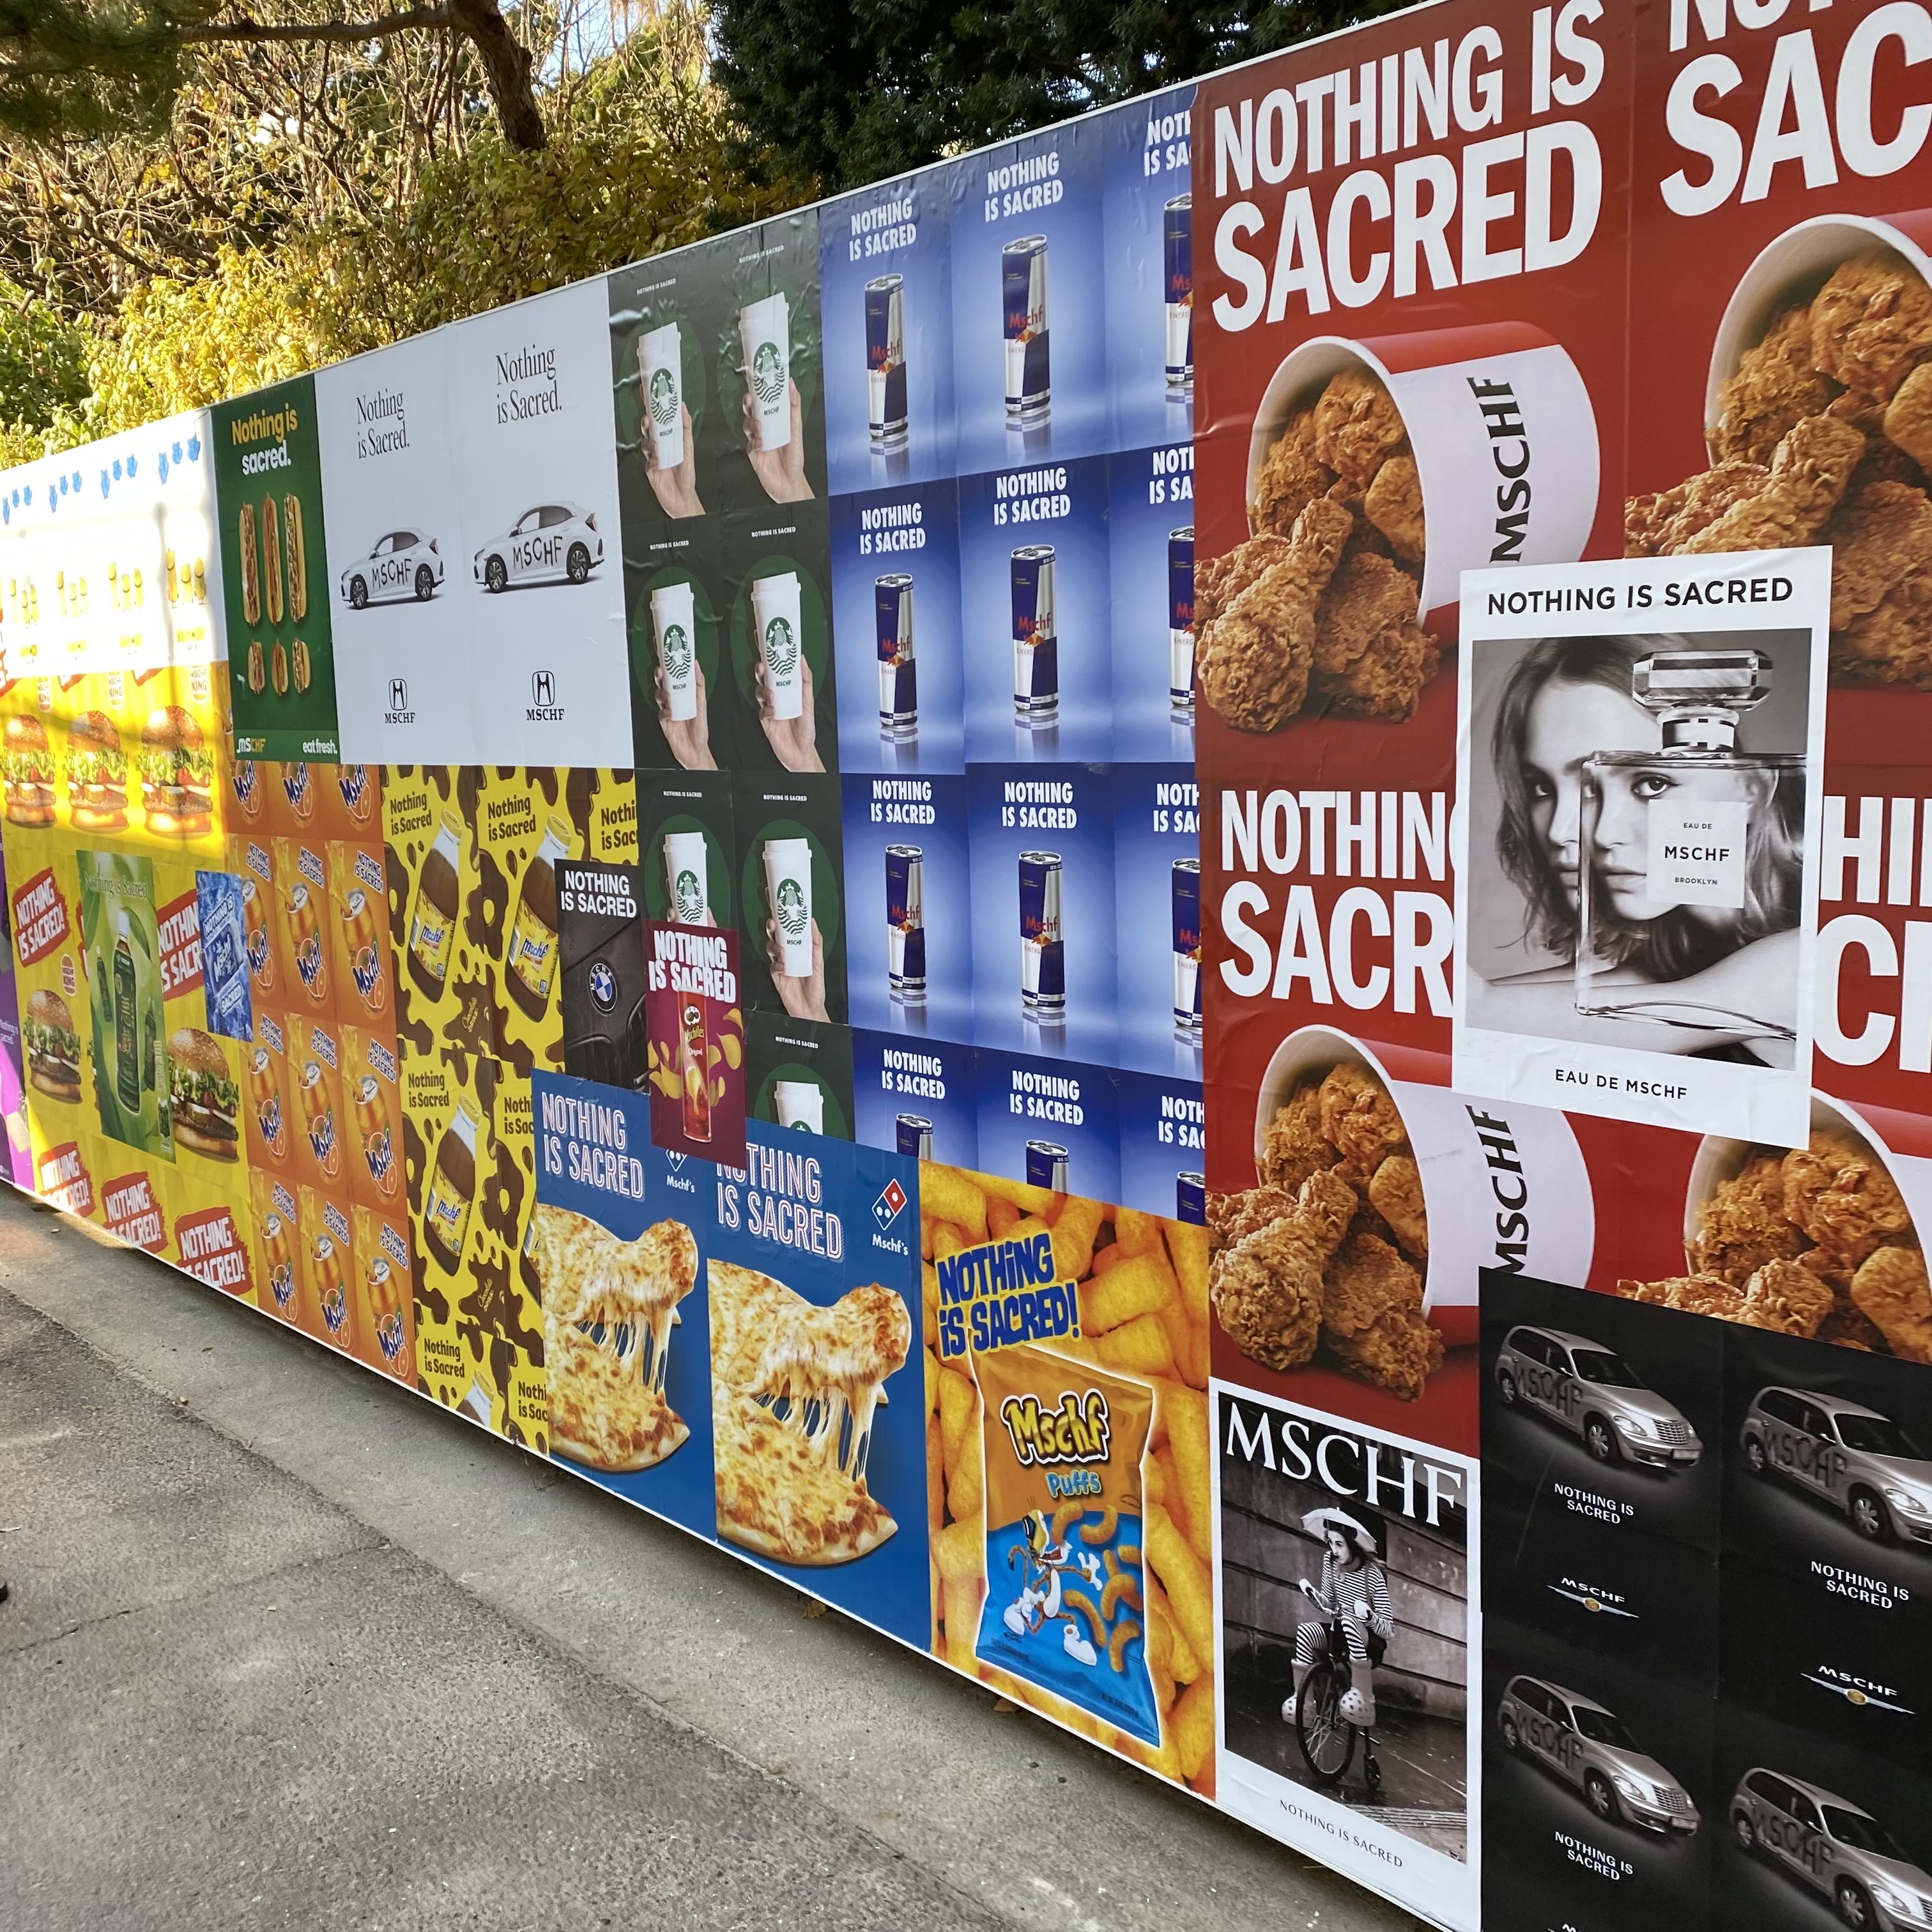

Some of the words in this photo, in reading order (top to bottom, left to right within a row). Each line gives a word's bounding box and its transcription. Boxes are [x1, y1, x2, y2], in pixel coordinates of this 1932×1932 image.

[1215, 25, 1503, 198] NOTHING
[1531, 0, 1605, 114] IS
[987, 151, 1059, 194] NOTHING
[985, 199, 999, 222] IS
[1002, 180, 1063, 217] SACRED
[850, 199, 912, 235] NOTHING
[1211, 120, 1602, 332] SACRED
[849, 240, 862, 261] IS
[864, 224, 916, 257] SACRED
[1009, 304, 1043, 328] Mschf
[496, 344, 556, 385] Nothing
[871, 338, 901, 360] Mschf
[356, 388, 404, 424] Nothing
[496, 394, 508, 424] is
[509, 380, 562, 421] Sacred.
[231, 410, 283, 445] Nothing
[284, 402, 298, 433] is
[358, 432, 367, 459] is
[368, 420, 410, 455] Sacred.
[241, 440, 291, 475] sacred.
[1466, 377, 1531, 564] MSCHF
[996, 467, 1067, 498] NOTHING
[861, 503, 923, 530] NOTHING
[993, 503, 1008, 525] IS
[1011, 494, 1071, 522] SACRED
[751, 529, 771, 538] NOTHING
[860, 535, 872, 554] IS
[875, 528, 926, 553] SACRED
[512, 535, 563, 569] MSCHF
[371, 558, 412, 588] MSCHF
[1488, 587, 1615, 615] NOTHING
[1627, 585, 1652, 608] IS
[1664, 577, 1793, 606] SACRED
[1018, 612, 1052, 631] Mschf
[882, 634, 910, 654] Mschf
[384, 712, 415, 723] MSCHF
[526, 709, 565, 721] MSCHF
[390, 792, 427, 815] Nothing
[873, 780, 932, 801] NOTHING
[1004, 782, 1073, 804] NOTHING
[391, 820, 399, 836] is
[399, 809, 432, 832] Sacred
[487, 797, 531, 820] Nothing
[871, 803, 883, 822] IS
[886, 804, 935, 825] SACRED
[1002, 807, 1015, 827] IS
[1020, 807, 1077, 829] SACRED
[488, 826, 497, 841] is
[499, 815, 536, 838] Sacred
[1222, 789, 1456, 882] NOTHIN
[1664, 846, 1730, 862] MSCHF
[121, 877, 148, 899] Sacred
[565, 870, 629, 895] NOTHING
[1674, 877, 1717, 885] BROOKLYN
[16, 876, 55, 929] NOTHING
[561, 891, 574, 910] IS
[578, 893, 636, 917] SACRED
[891, 906, 919, 920] Mschf
[18, 932, 29, 961] IS
[27, 902, 65, 954] SACRED!
[204, 901, 228, 937] NOTHING
[1026, 916, 1058, 933] Mschf
[654, 930, 727, 969] NOTHING
[590, 965, 613, 990] MSCHF
[648, 960, 666, 991] IS
[670, 962, 735, 1003] SACRED
[221, 983, 241, 1015] SACRED
[371, 1038, 394, 1067] NOTHING
[775, 1036, 795, 1045] NOTHING
[801, 1040, 818, 1049] SACRED
[884, 1049, 942, 1077] NOTHING
[408, 1070, 445, 1091] Nothing
[882, 1070, 894, 1090] IS
[897, 1073, 946, 1100] SACRED
[1012, 1070, 1080, 1101] NOTHING
[1555, 1069, 1589, 1085] EAU
[1597, 1075, 1619, 1089] DE
[1626, 1079, 1687, 1100] MSCHF
[409, 1092, 416, 1108] is
[417, 1091, 449, 1107] Sacred
[1010, 1094, 1022, 1115] IS
[1027, 1097, 1084, 1126] SACRED
[542, 1092, 626, 1150] NOTHING
[544, 1134, 562, 1174] IS
[568, 1142, 643, 1199] SACRED
[666, 1175, 695, 1193] Mschf's
[105, 1181, 150, 1223] NOTHING
[717, 1183, 739, 1227] IS
[747, 1191, 842, 1259] SACRED
[180, 1217, 233, 1261] NOTHING
[383, 1222, 406, 1254] NOTHING
[872, 1234, 908, 1255] Mschf's
[970, 1282, 1080, 1351] SACRED!
[424, 1338, 460, 1361] Nothing
[425, 1356, 432, 1372] is
[433, 1360, 464, 1378] Sacred
[1000, 1389, 1110, 1464] Mschf
[1226, 1402, 1462, 1526] MSCHF
[1554, 1483, 1616, 1512] NOTHING
[1621, 1503, 1634, 1517] IS
[1567, 1500, 1621, 1524] SACRED
[1561, 1577, 1625, 1604] MSCHF
[1811, 1561, 1887, 1594] NOTHING
[1894, 1586, 1909, 1601] IS
[1826, 1579, 1892, 1609] SACRED
[1818, 1665, 1897, 1697] MSCHF
[1280, 1799, 1335, 1834] NOTHING
[1339, 1828, 1349, 1841] IS
[1353, 1836, 1402, 1867] SACRED
[1555, 1831, 1616, 1867] NOTHING
[1620, 1859, 1634, 1875] IS
[1567, 1850, 1620, 1881] SACRED
